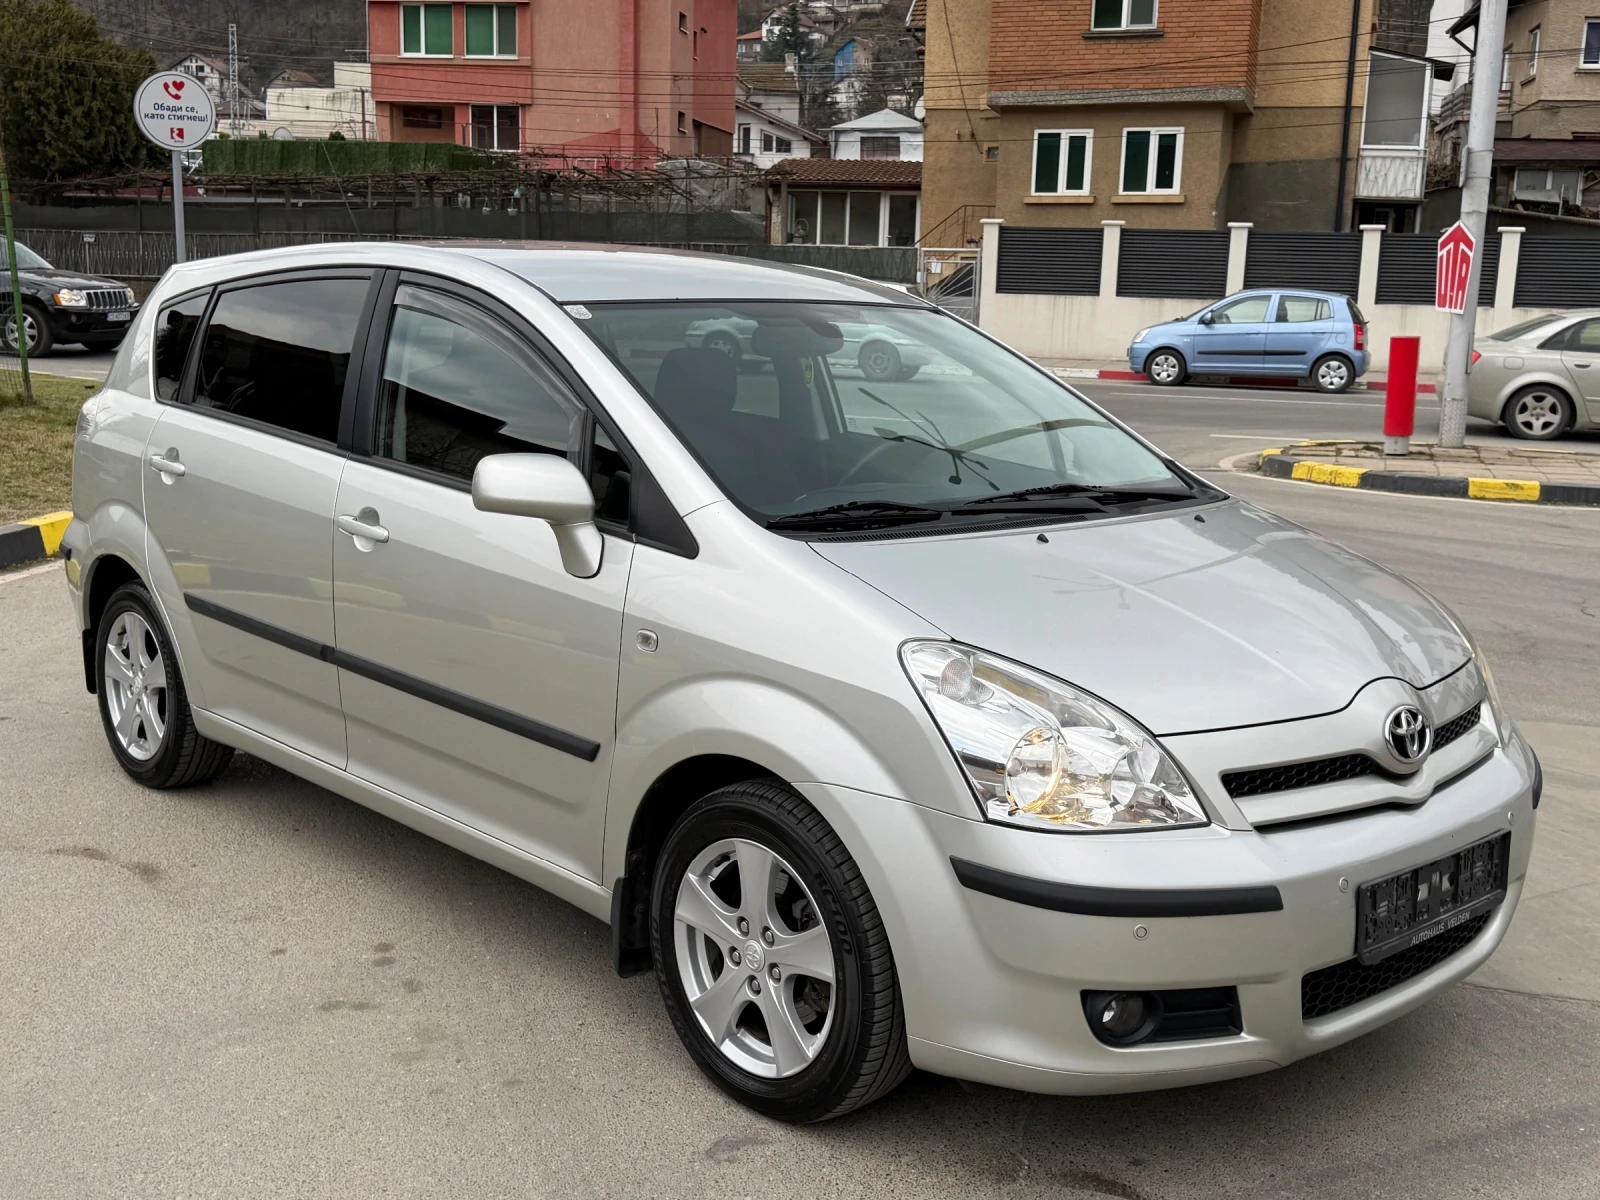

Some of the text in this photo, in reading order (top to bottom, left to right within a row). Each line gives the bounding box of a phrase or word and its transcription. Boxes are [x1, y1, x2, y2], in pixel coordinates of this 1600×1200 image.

[153, 102, 199, 114] Обади се,
[144, 112, 208, 123] като стигнеш!
[1410, 910, 1471, 947] AUTOHAUS VELDEN
